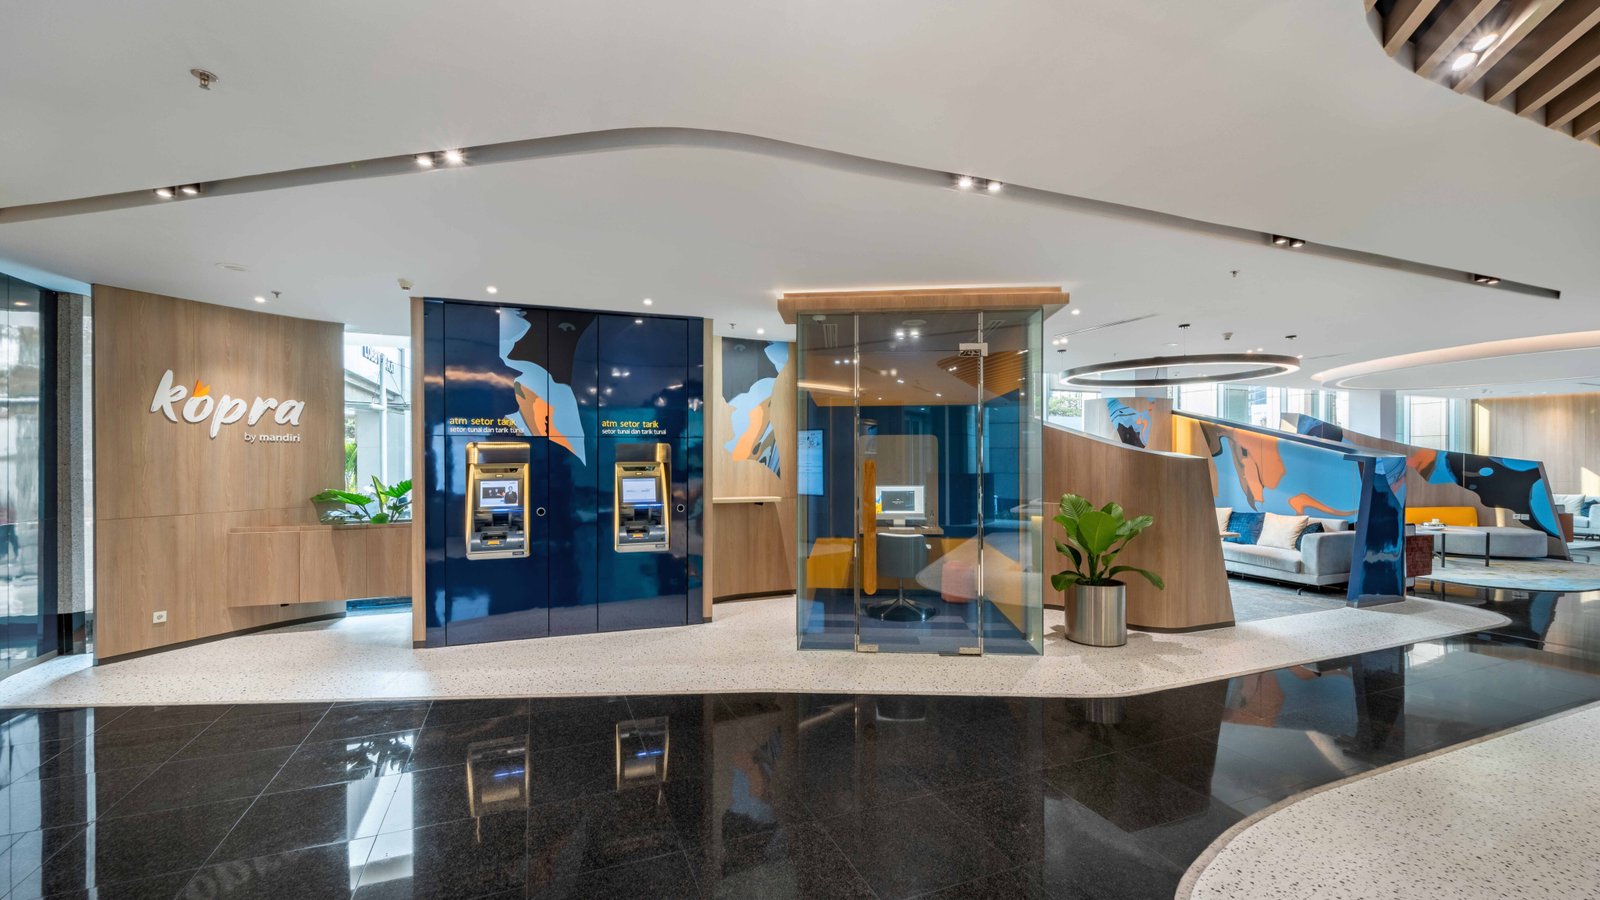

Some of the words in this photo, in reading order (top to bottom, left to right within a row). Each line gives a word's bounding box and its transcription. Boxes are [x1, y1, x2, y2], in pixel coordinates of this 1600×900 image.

[150, 369, 305, 439] kopra
[449, 417, 468, 425] atm
[470, 417, 494, 426] setor
[497, 417, 517, 426] tarik
[620, 420, 640, 428] setor
[642, 420, 659, 428] tarik
[244, 432, 257, 443] by
[259, 433, 301, 442] mandiri
